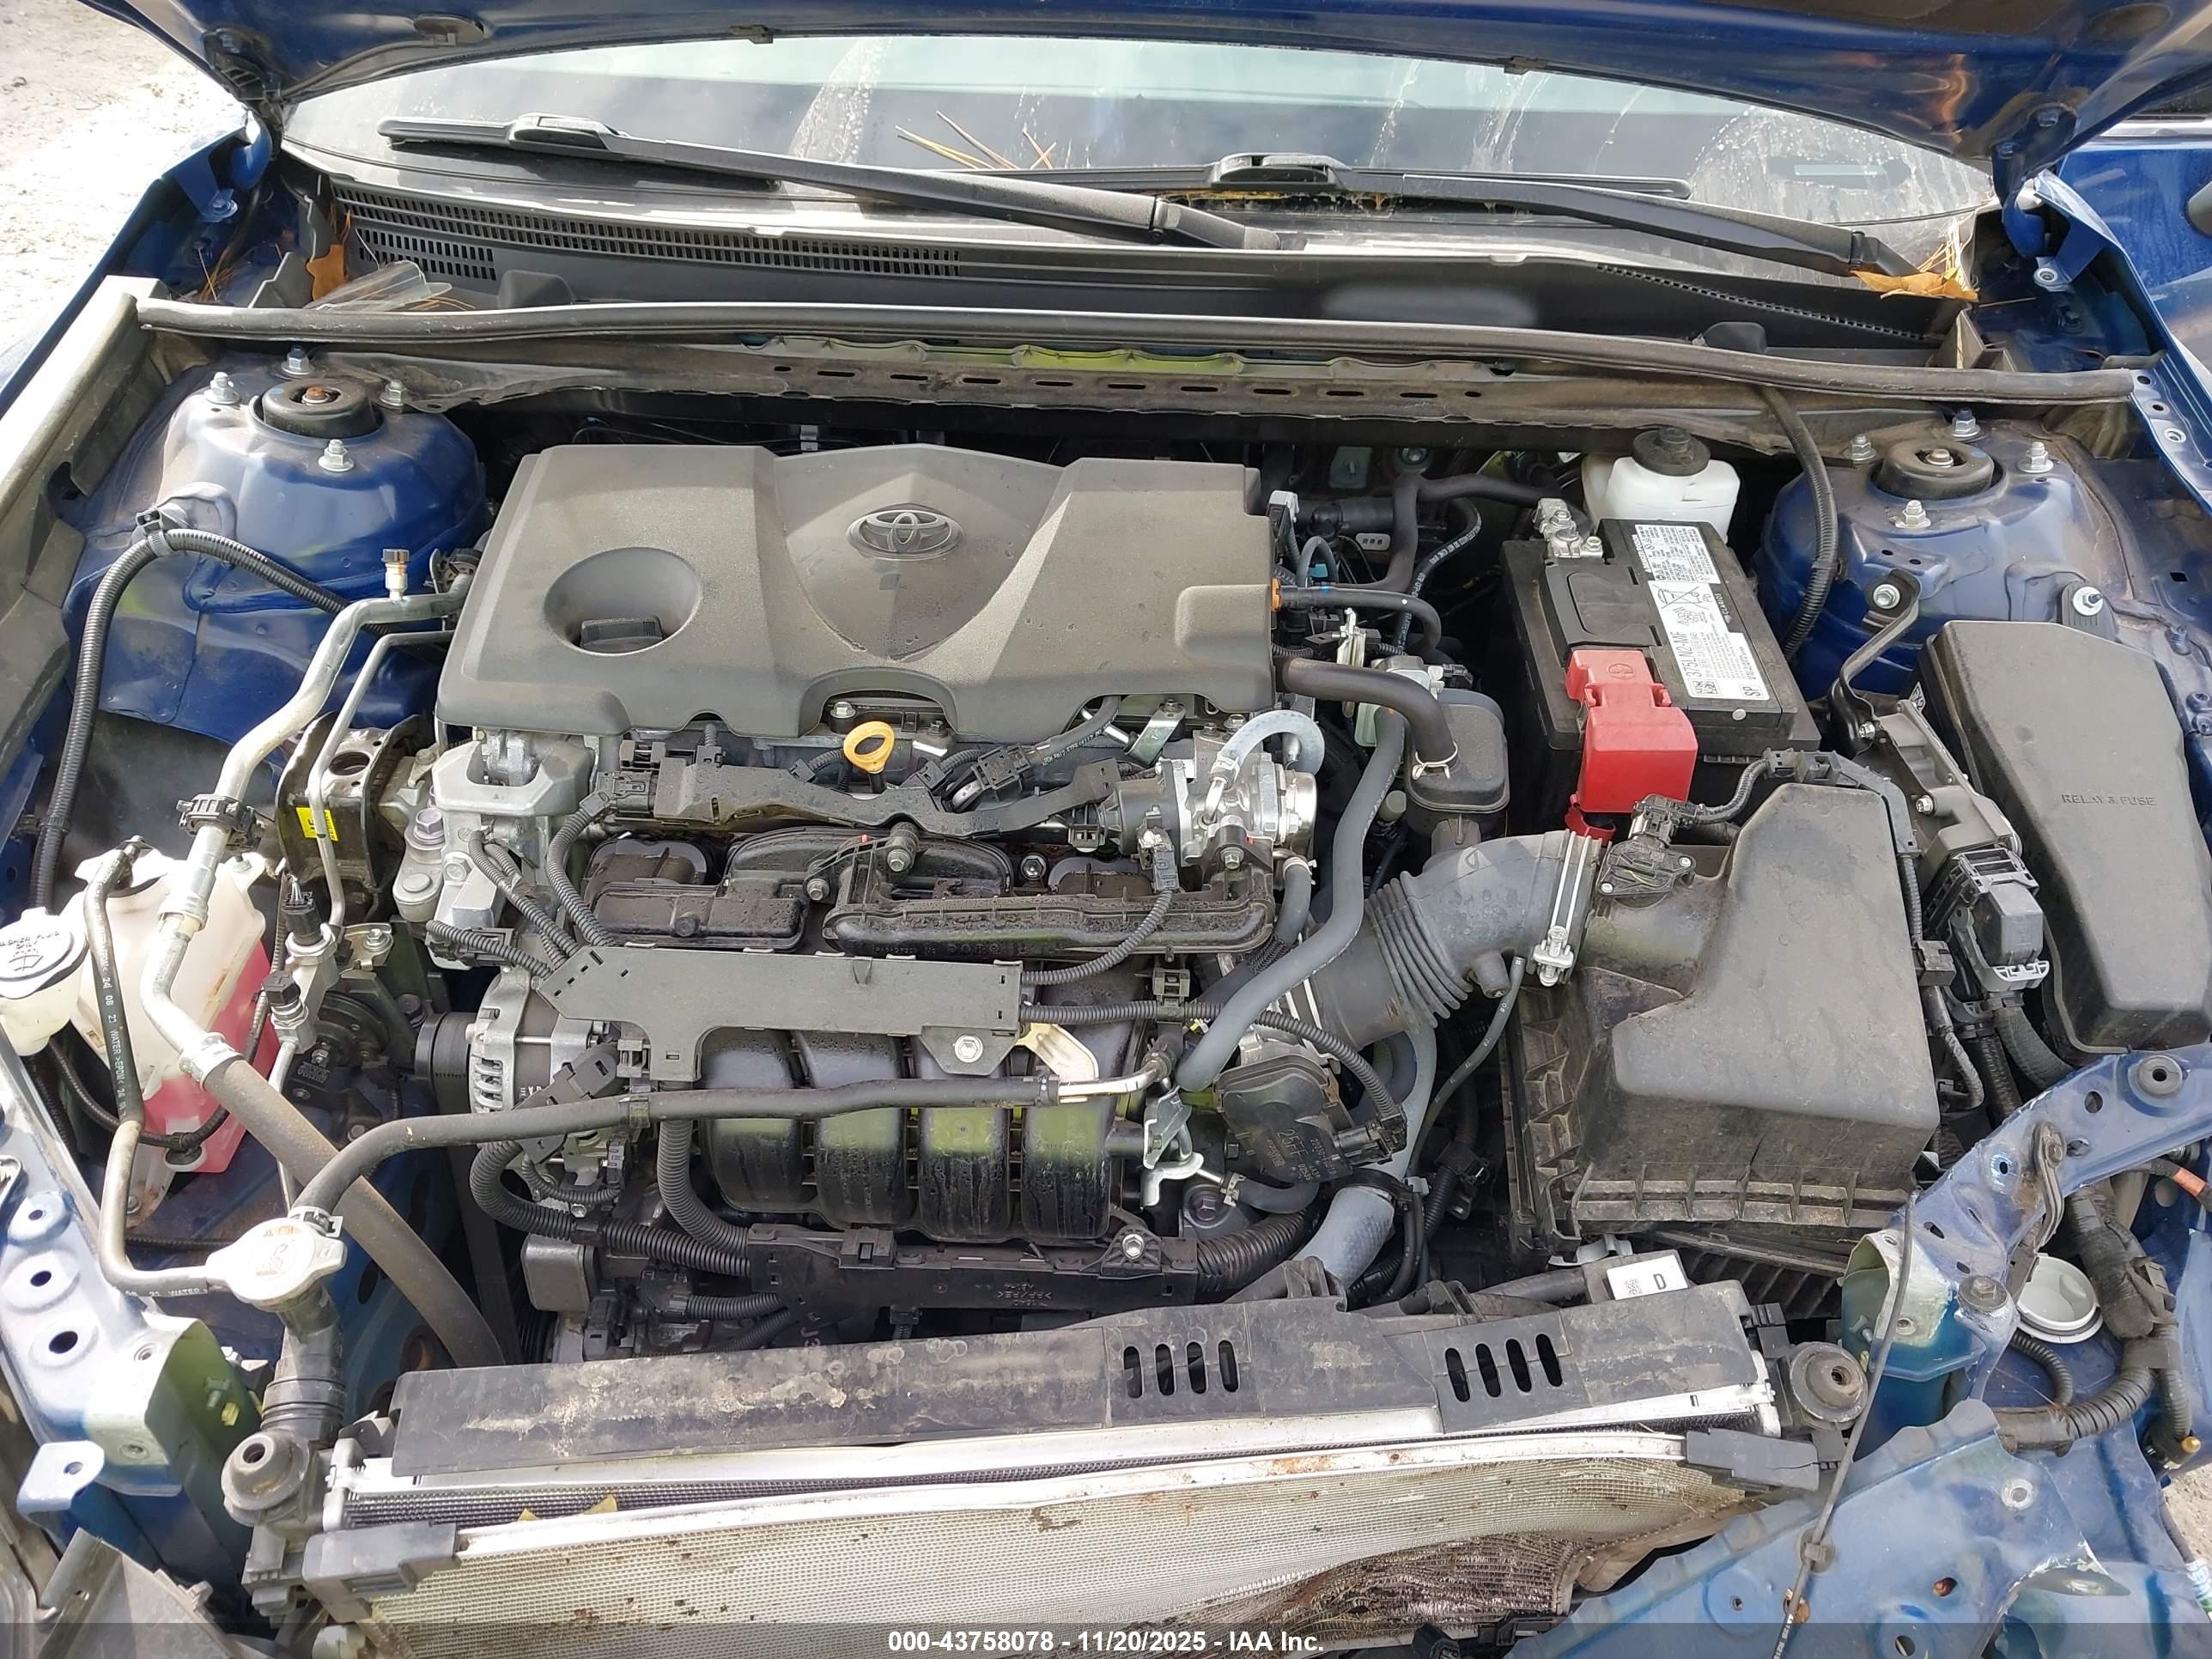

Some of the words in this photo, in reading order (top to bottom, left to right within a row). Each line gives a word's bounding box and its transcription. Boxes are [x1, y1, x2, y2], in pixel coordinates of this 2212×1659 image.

[1715, 592, 1729, 615] CLARIOS
[1740, 685, 1761, 696] SP
[2061, 793, 2103, 805] RELAY
[2120, 795, 2157, 806] FUSE
[109, 1029, 123, 1055] WATER
[1653, 1273, 1666, 1290] D
